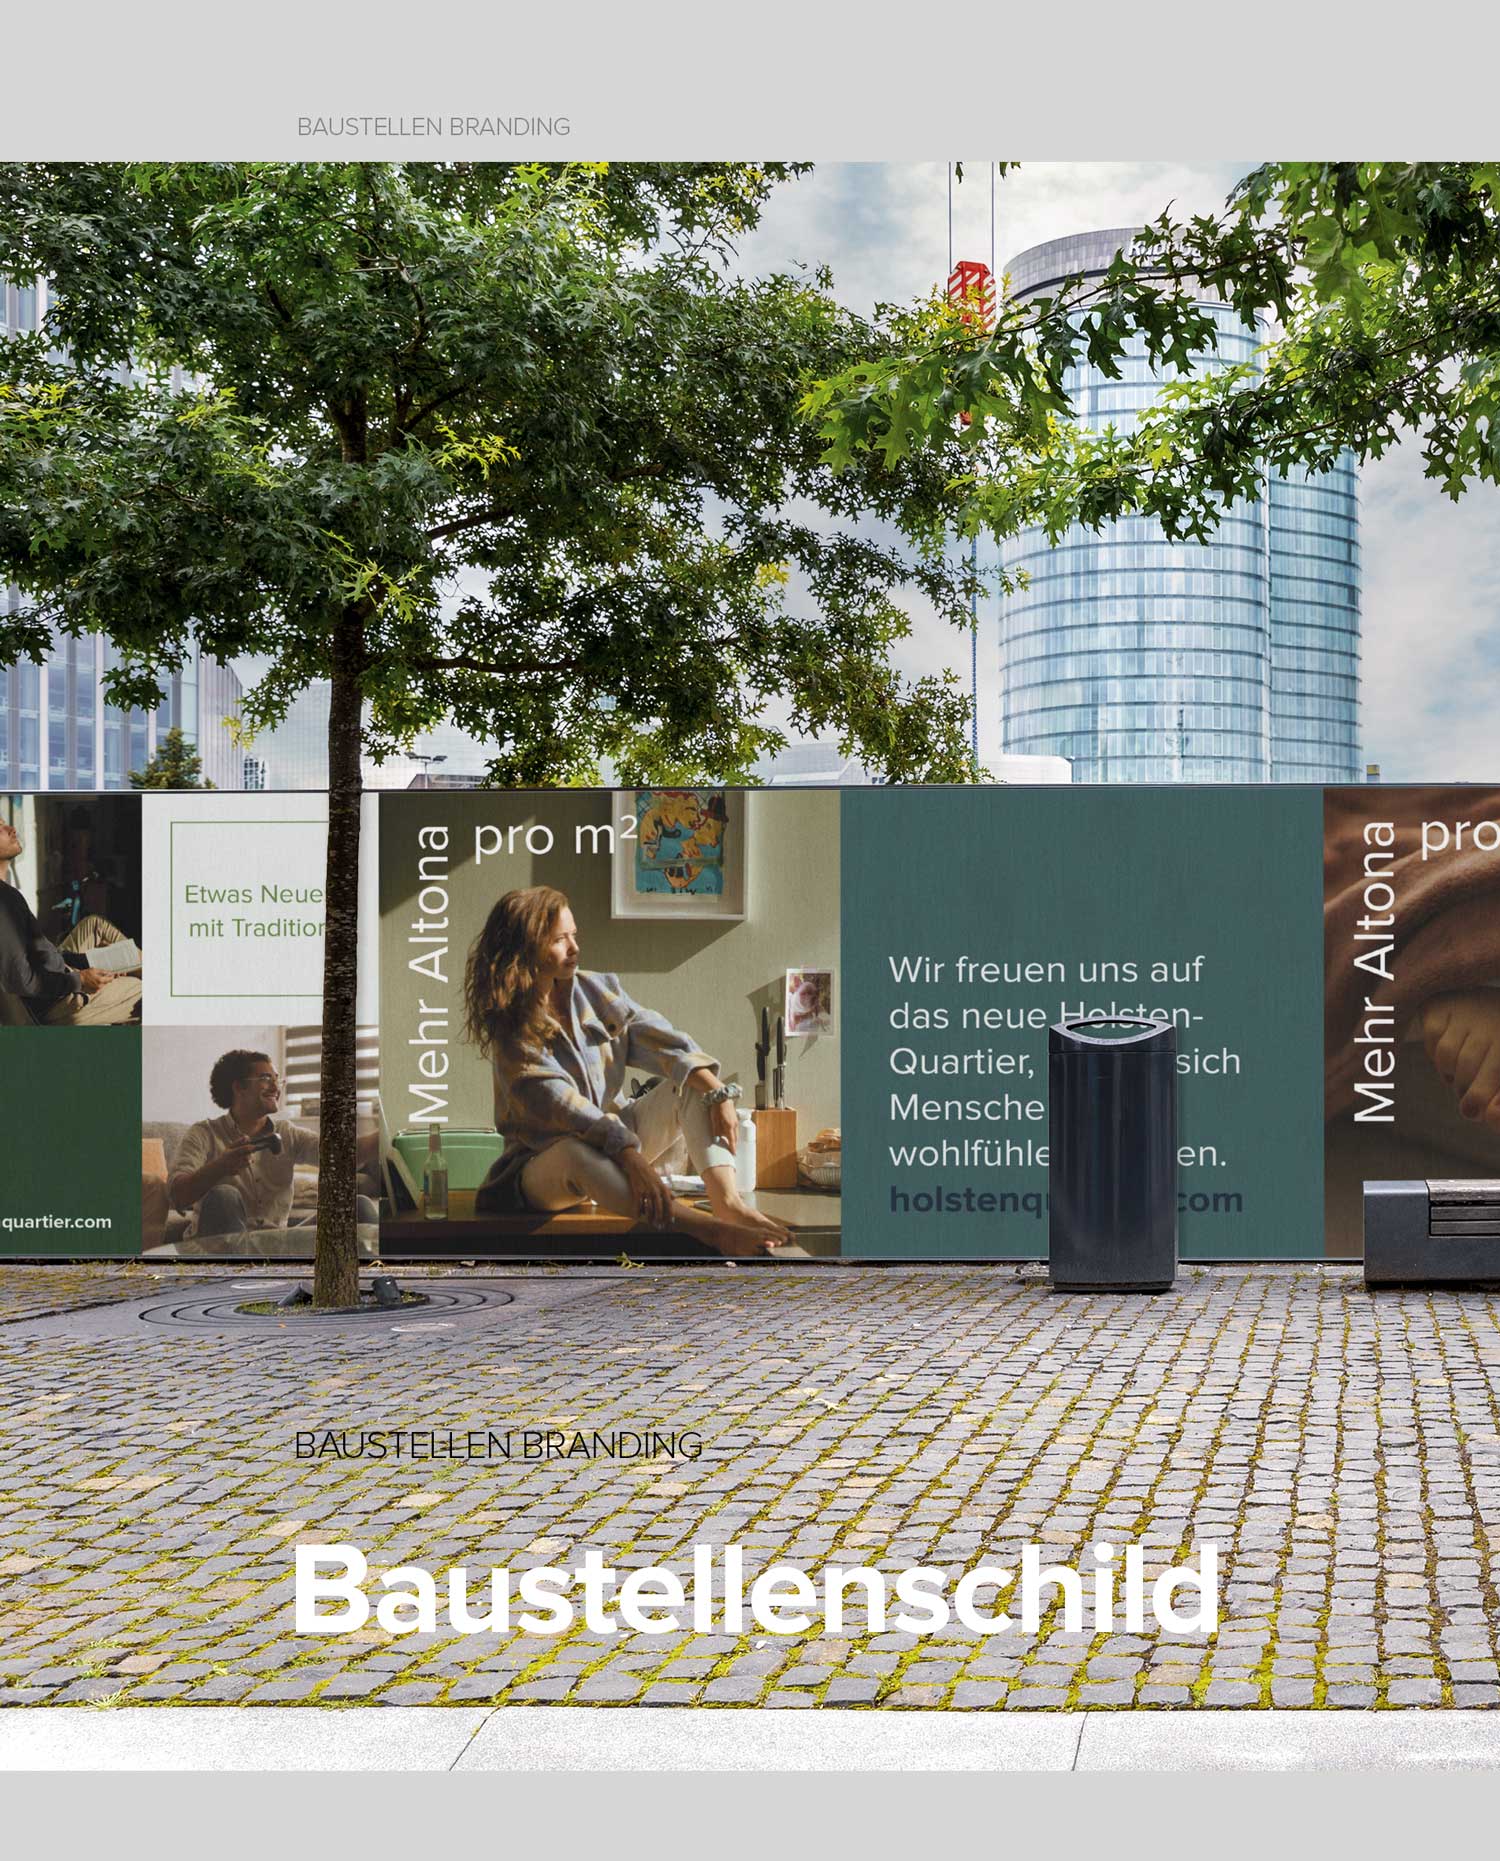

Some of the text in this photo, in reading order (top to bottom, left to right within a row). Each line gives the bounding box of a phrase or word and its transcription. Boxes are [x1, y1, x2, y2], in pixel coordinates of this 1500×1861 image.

[476, 826, 553, 864] pro
[1423, 822, 1500, 860] pro
[186, 885, 323, 903] Etwas Neue
[190, 919, 224, 937] mit
[409, 827, 448, 1122] Mehr Altona
[889, 956, 1205, 982] Wir freuen uns auf
[1354, 823, 1394, 1121] Mehr Altona
[890, 1002, 948, 1028] das
[963, 1009, 1046, 1028] neue
[890, 1048, 1239, 1078] Quartier, sich
[892, 1094, 1044, 1120] Mensche
[889, 1140, 1048, 1166] wohlfühle
[0, 1214, 111, 1232] quartier.com
